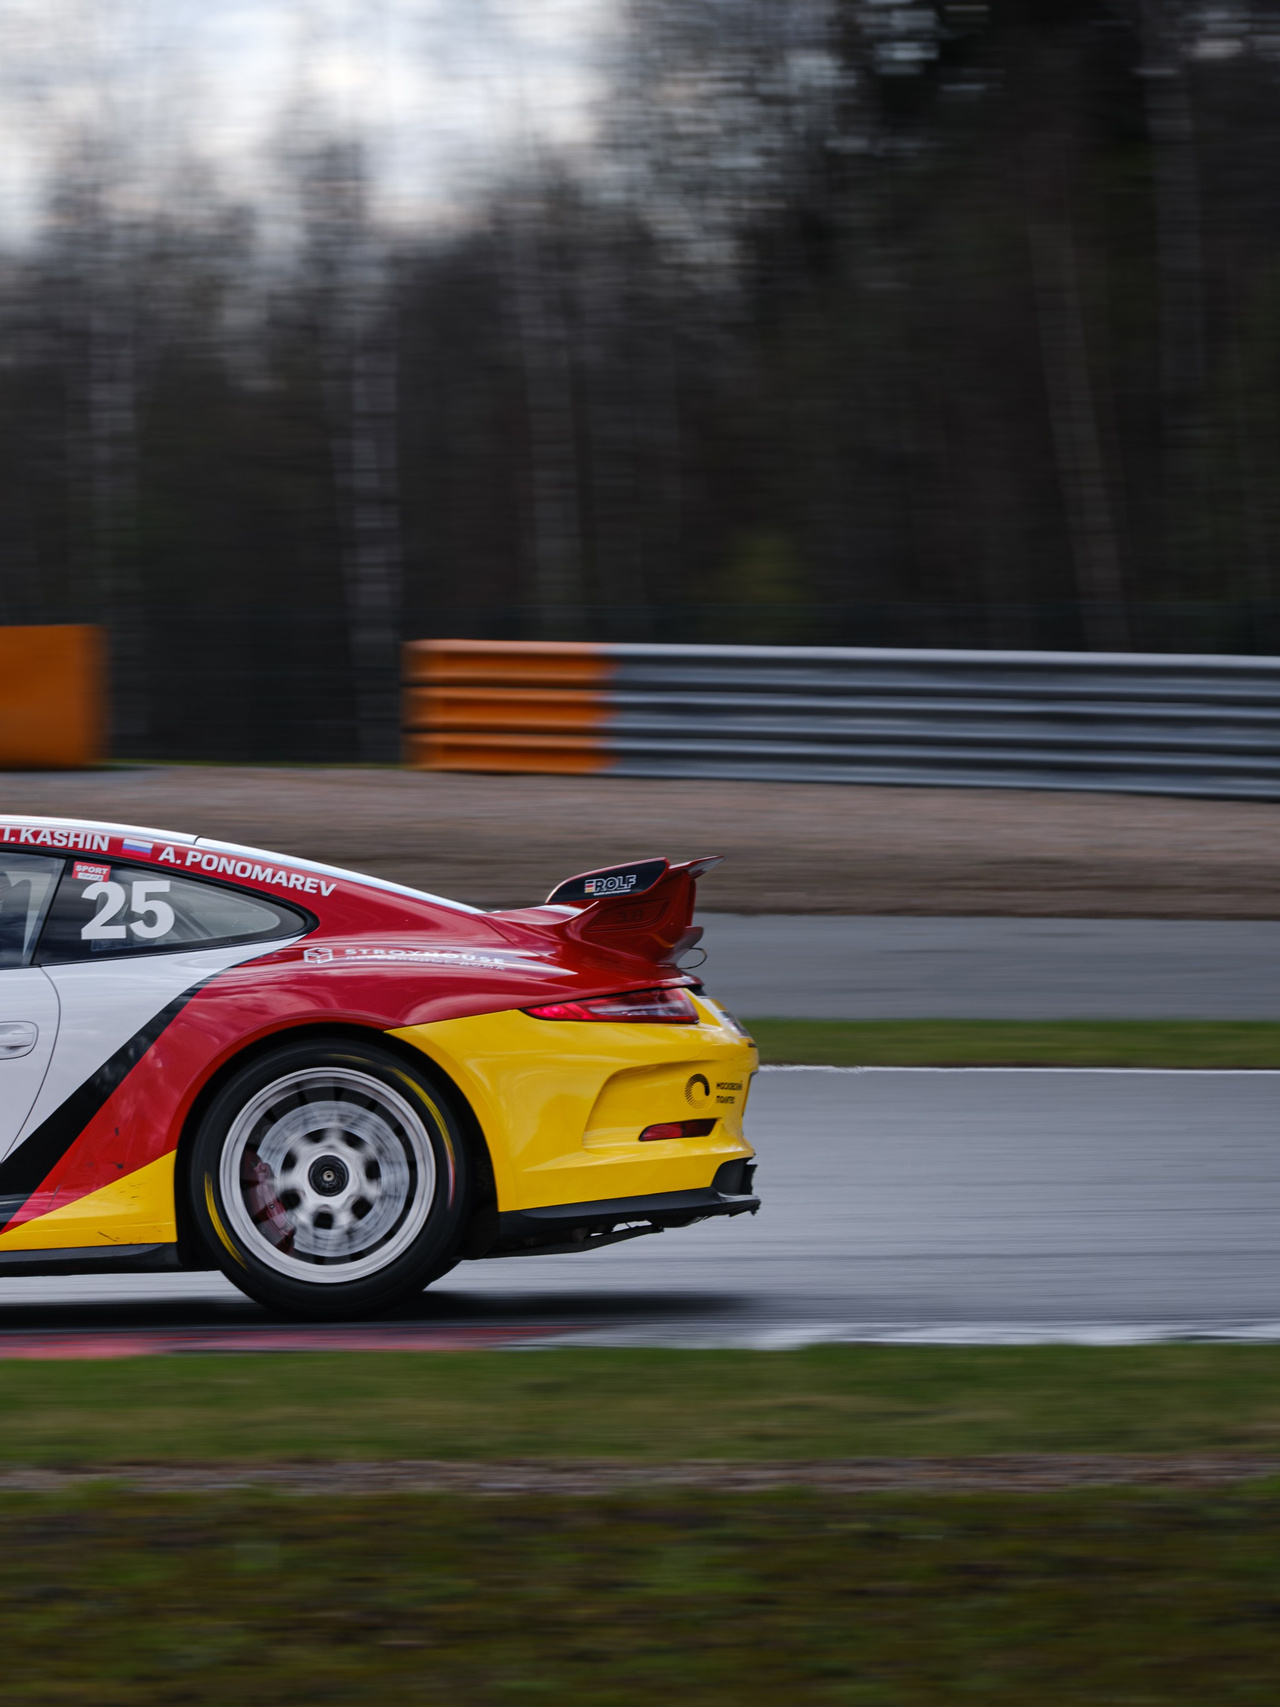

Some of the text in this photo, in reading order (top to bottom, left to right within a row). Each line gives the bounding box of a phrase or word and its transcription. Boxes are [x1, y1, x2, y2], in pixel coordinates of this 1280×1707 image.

[20, 827, 110, 852] KASHIN
[75, 864, 109, 875] SPORT
[158, 846, 338, 897] A. PONOMAREV
[594, 874, 637, 893] ROLF
[81, 880, 175, 940] 25
